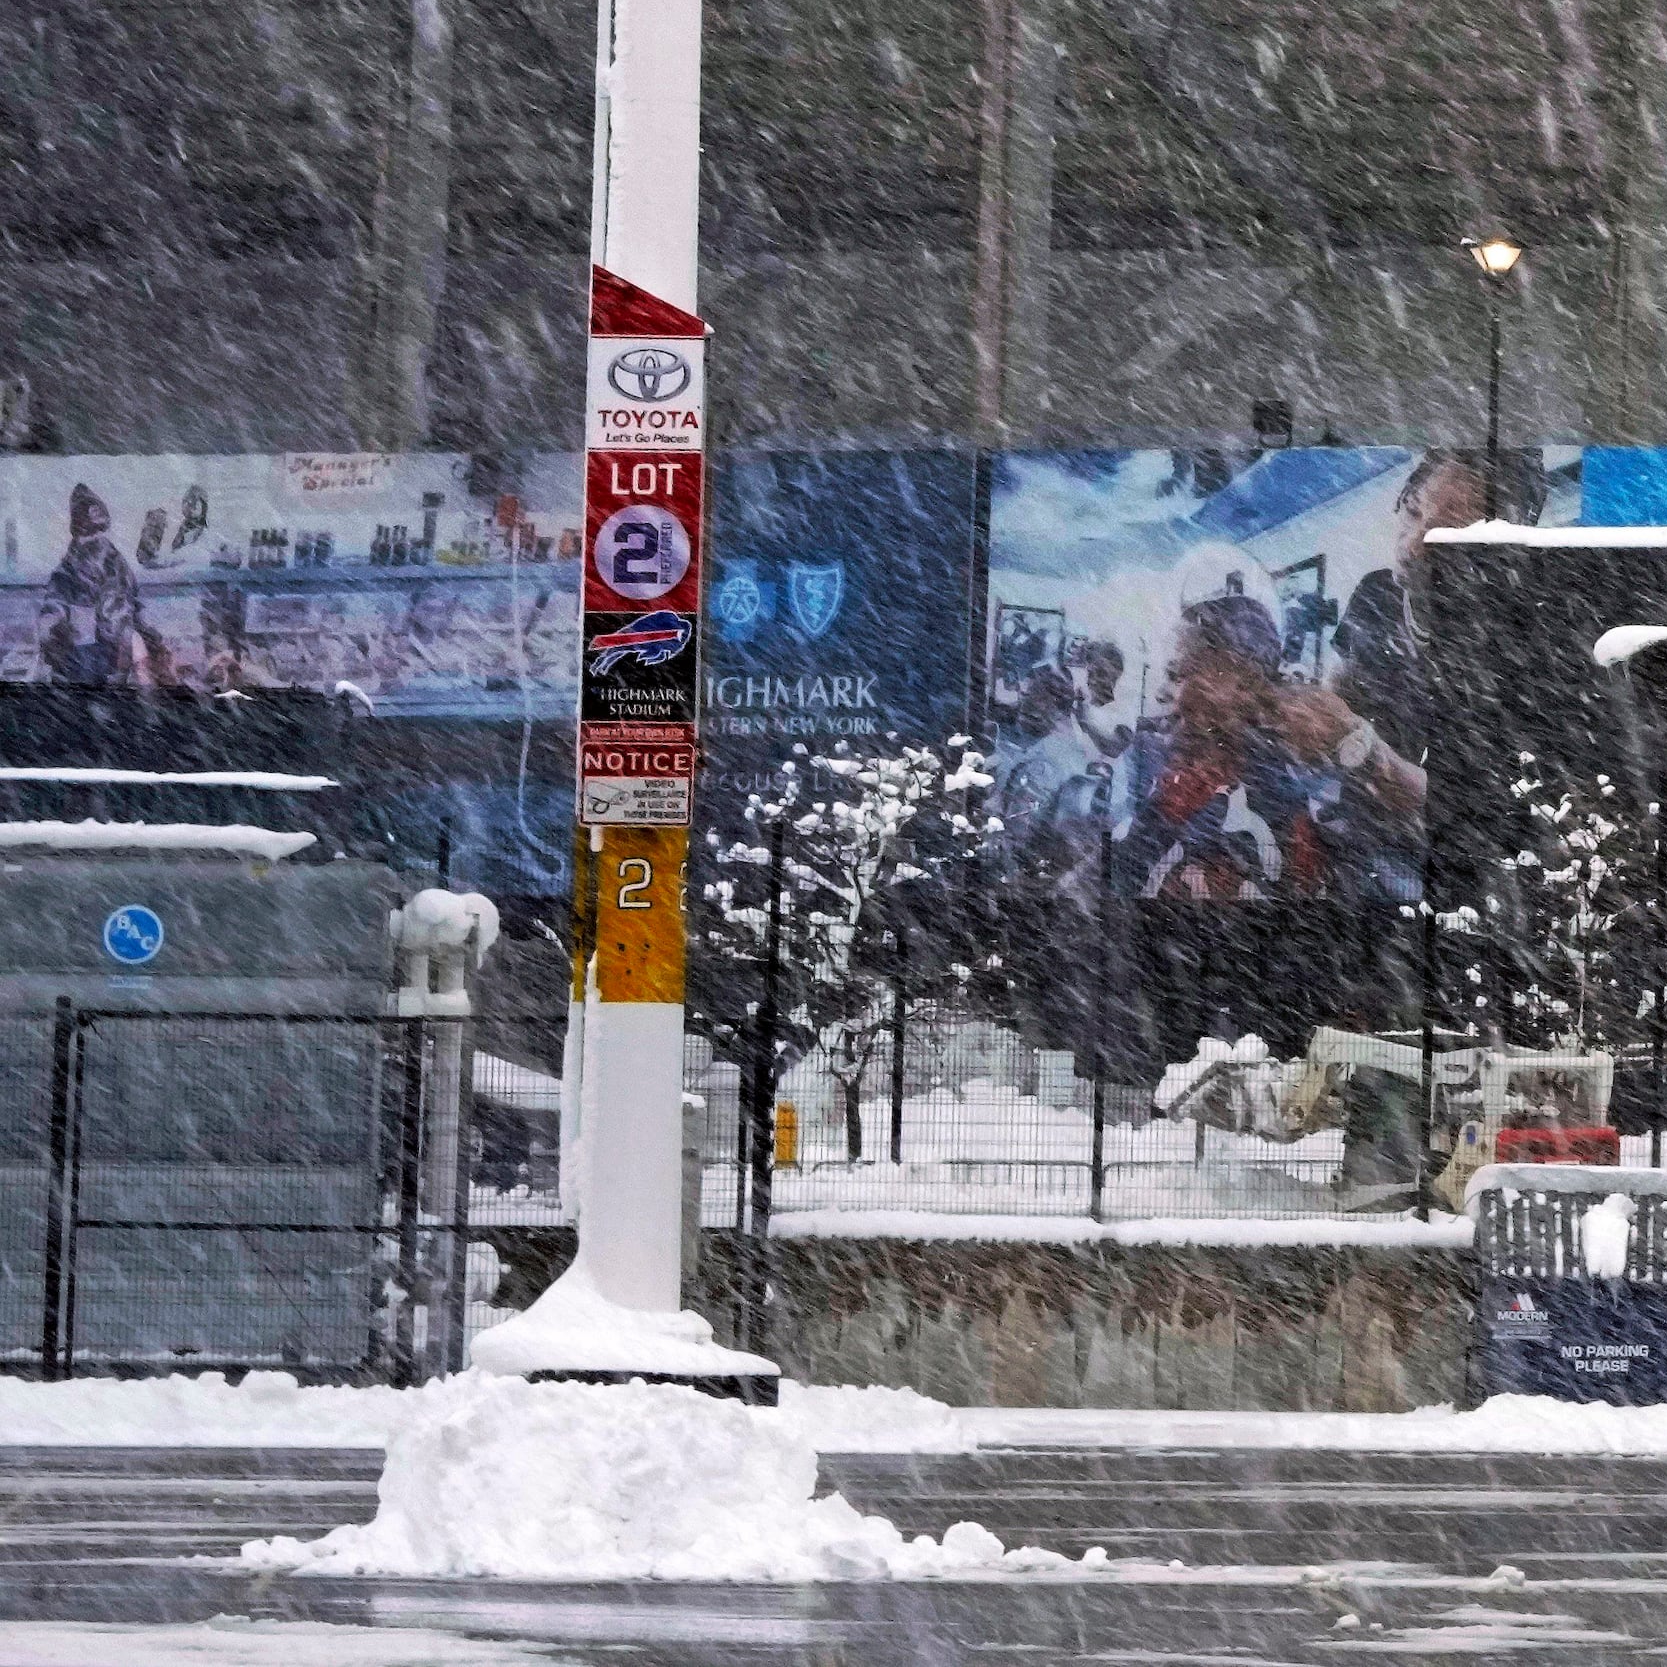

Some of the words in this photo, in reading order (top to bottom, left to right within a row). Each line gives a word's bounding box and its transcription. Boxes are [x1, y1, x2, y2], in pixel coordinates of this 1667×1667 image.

[598, 410, 699, 429] TOYOTA
[605, 433, 632, 443] Let's
[635, 433, 650, 443] Go
[653, 434, 690, 444] Places
[611, 463, 683, 495] LOT
[613, 522, 659, 583] 2
[600, 688, 686, 702] HIGHMARK
[706, 675, 879, 709] IGHMARK
[609, 703, 671, 716] STADIUM
[708, 716, 768, 735] STERN
[774, 716, 817, 735] NEW
[826, 716, 878, 735] YORK
[584, 752, 691, 771] NOTICE
[619, 858, 652, 908] 2
[1497, 1310, 1549, 1321] MODERN
[1561, 1345, 1582, 1358] NO
[1586, 1344, 1649, 1358] PARKING
[1575, 1359, 1629, 1372] PLEASE
